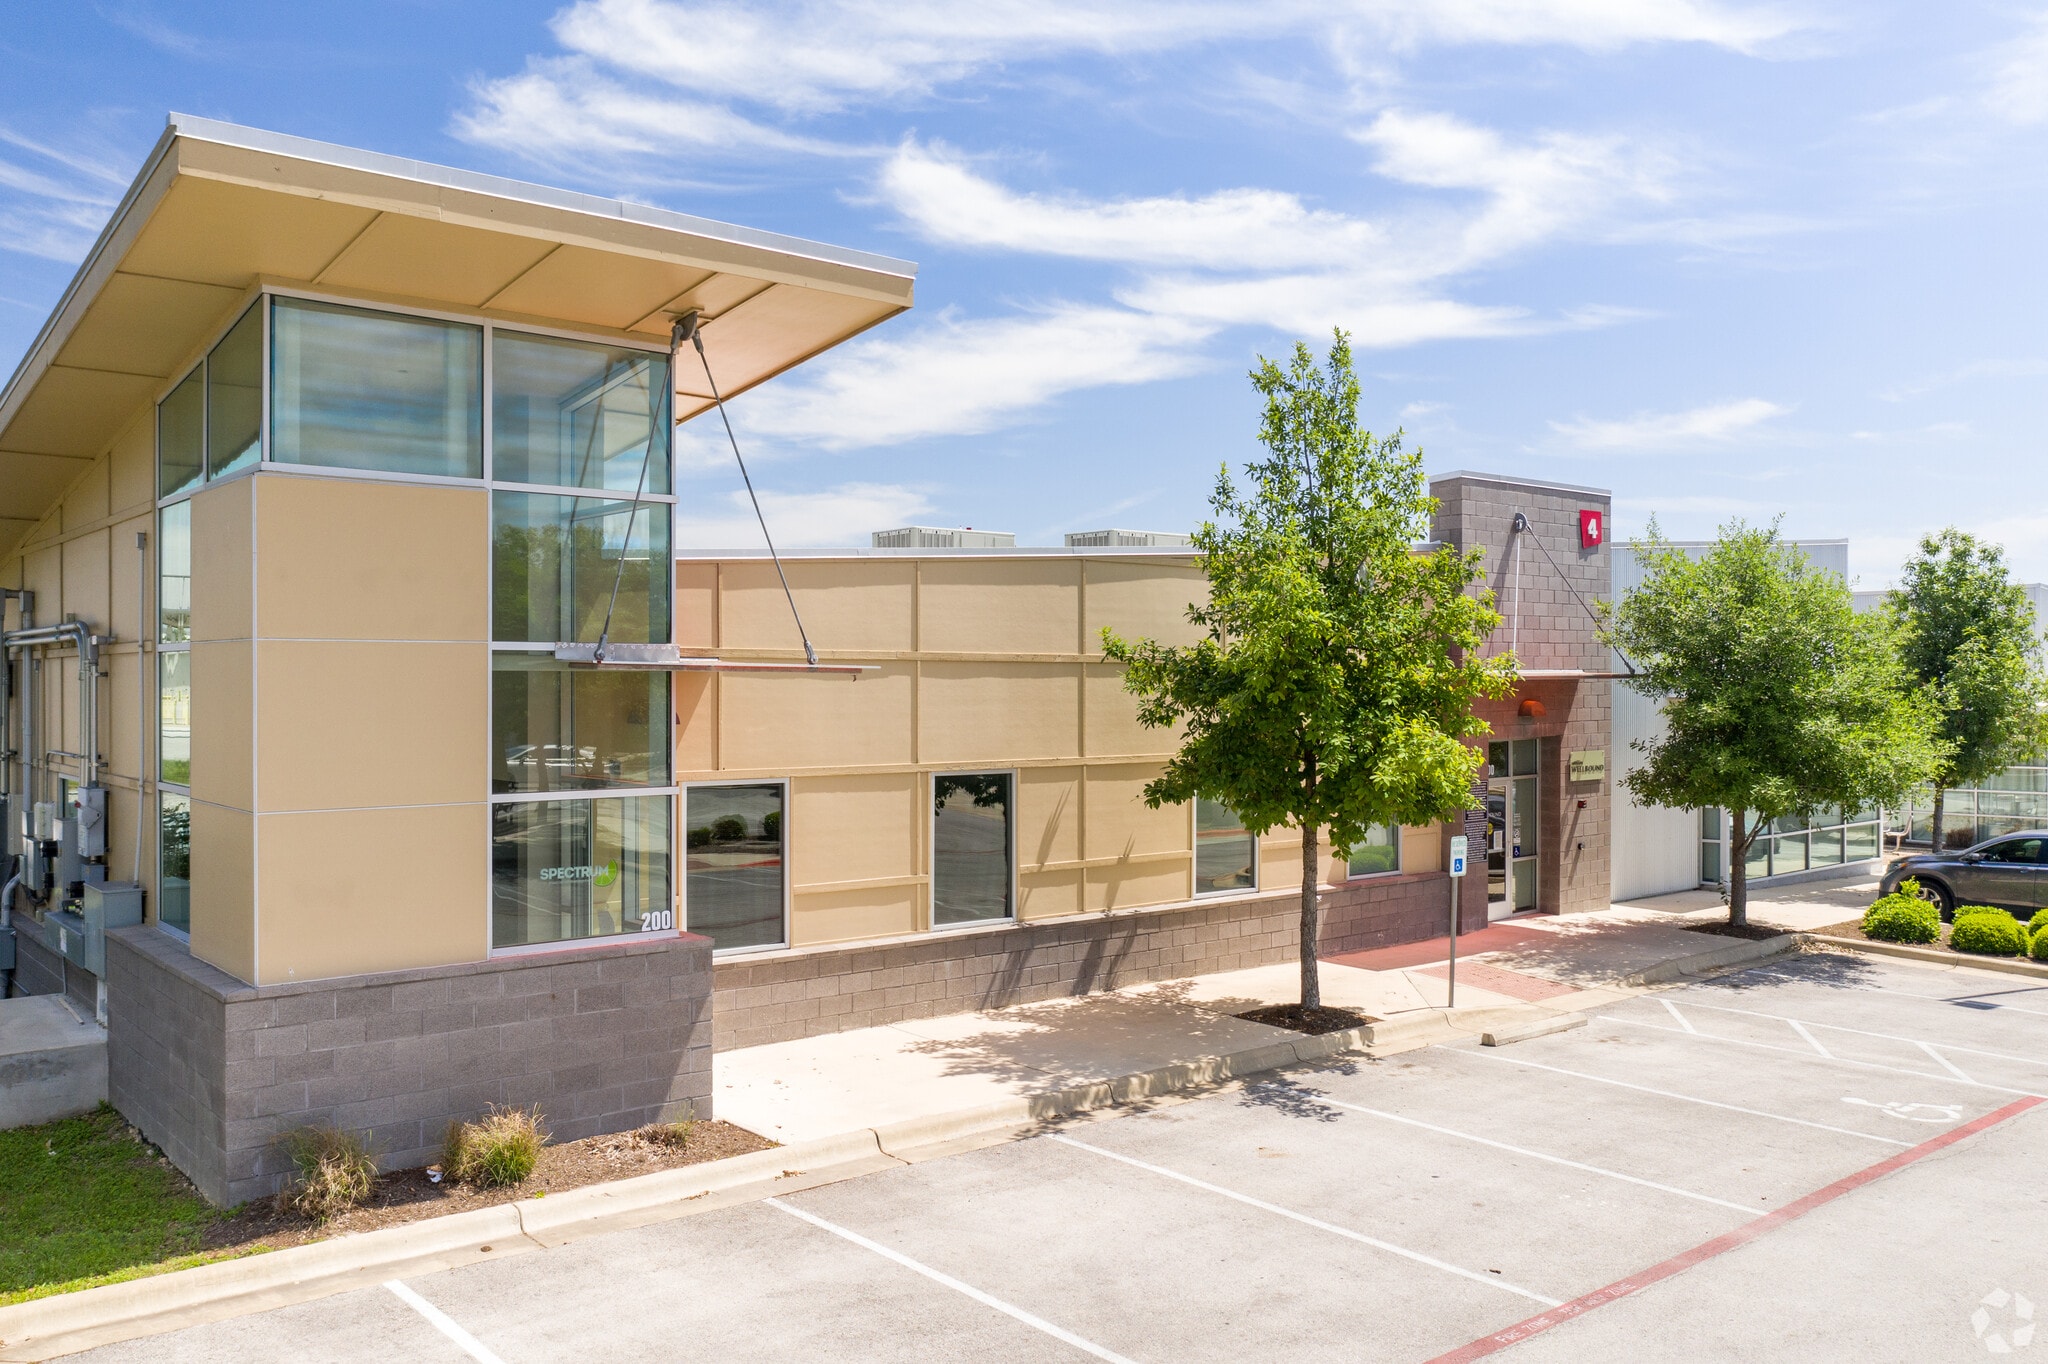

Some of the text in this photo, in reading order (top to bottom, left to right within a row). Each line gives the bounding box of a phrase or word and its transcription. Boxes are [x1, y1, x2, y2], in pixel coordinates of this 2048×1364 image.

[1588, 519, 1598, 538] 4
[1571, 764, 1604, 773] WELLBOUND
[540, 865, 608, 880] SPECTRUM
[641, 910, 671, 932] 200
[1495, 1329, 1526, 1344] FIRE
[1521, 1317, 1555, 1332] ZONE
